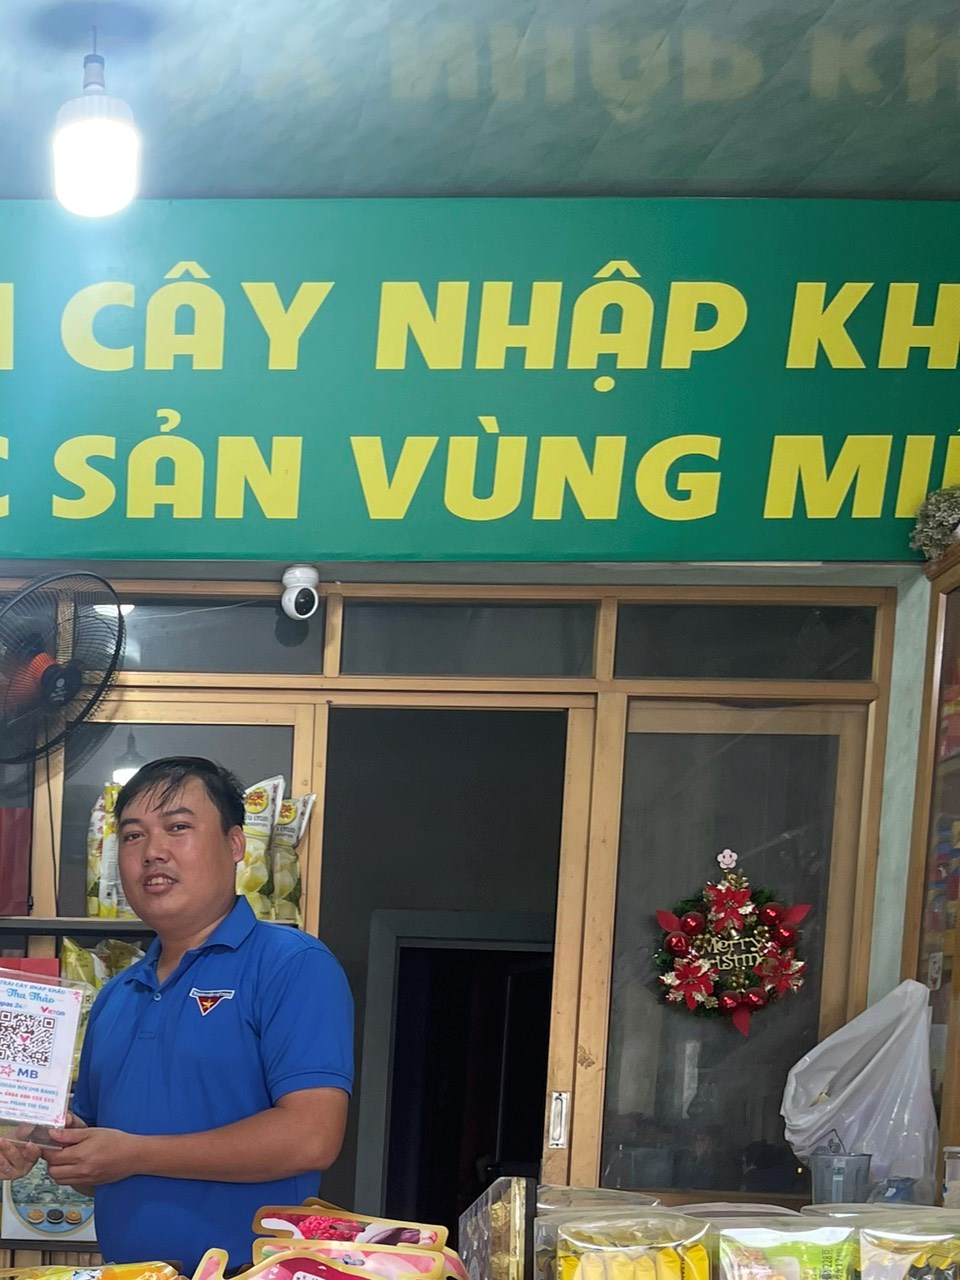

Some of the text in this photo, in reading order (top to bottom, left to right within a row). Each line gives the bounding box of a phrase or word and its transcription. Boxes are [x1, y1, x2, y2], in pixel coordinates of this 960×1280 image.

[60, 261, 335, 371] CÂY
[375, 260, 748, 392] NHẬP
[786, 281, 960, 370] KH
[52, 409, 303, 519] SẢN
[350, 416, 721, 521] VÙNG
[17, 1068, 38, 1079] MB
